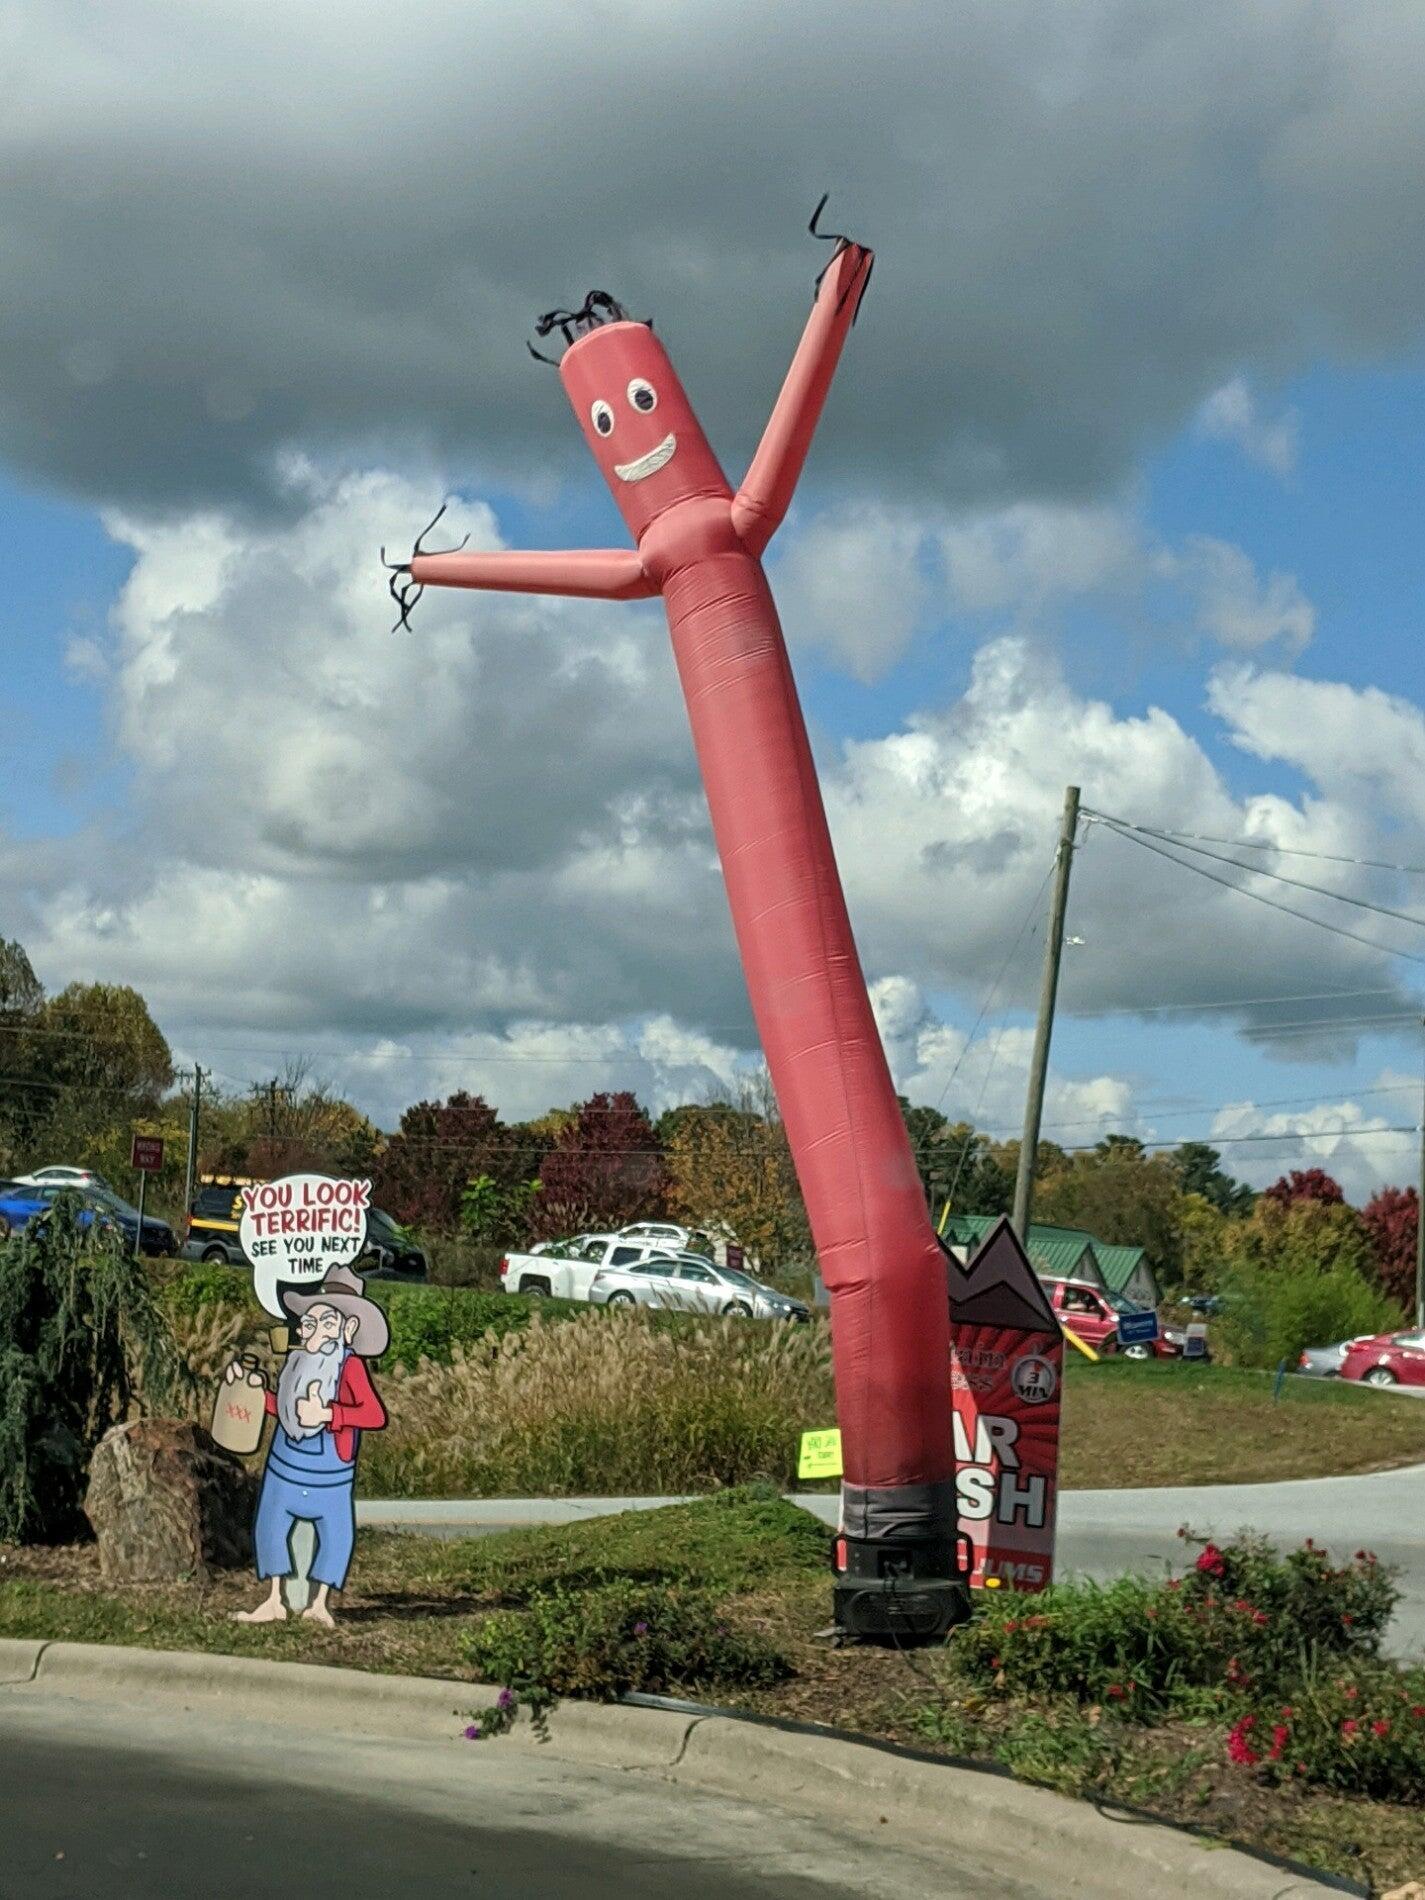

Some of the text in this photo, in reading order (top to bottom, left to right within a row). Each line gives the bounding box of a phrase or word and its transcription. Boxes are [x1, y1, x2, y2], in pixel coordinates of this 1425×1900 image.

[243, 1183, 293, 1211] YOU
[303, 1181, 369, 1207] LOOK
[250, 1208, 361, 1236] TERRIFIC!
[251, 1236, 361, 1258] SEE YOU NEXT
[288, 1257, 324, 1274] TIME
[1027, 1371, 1040, 1384] 3
[955, 1466, 1046, 1527] SH
